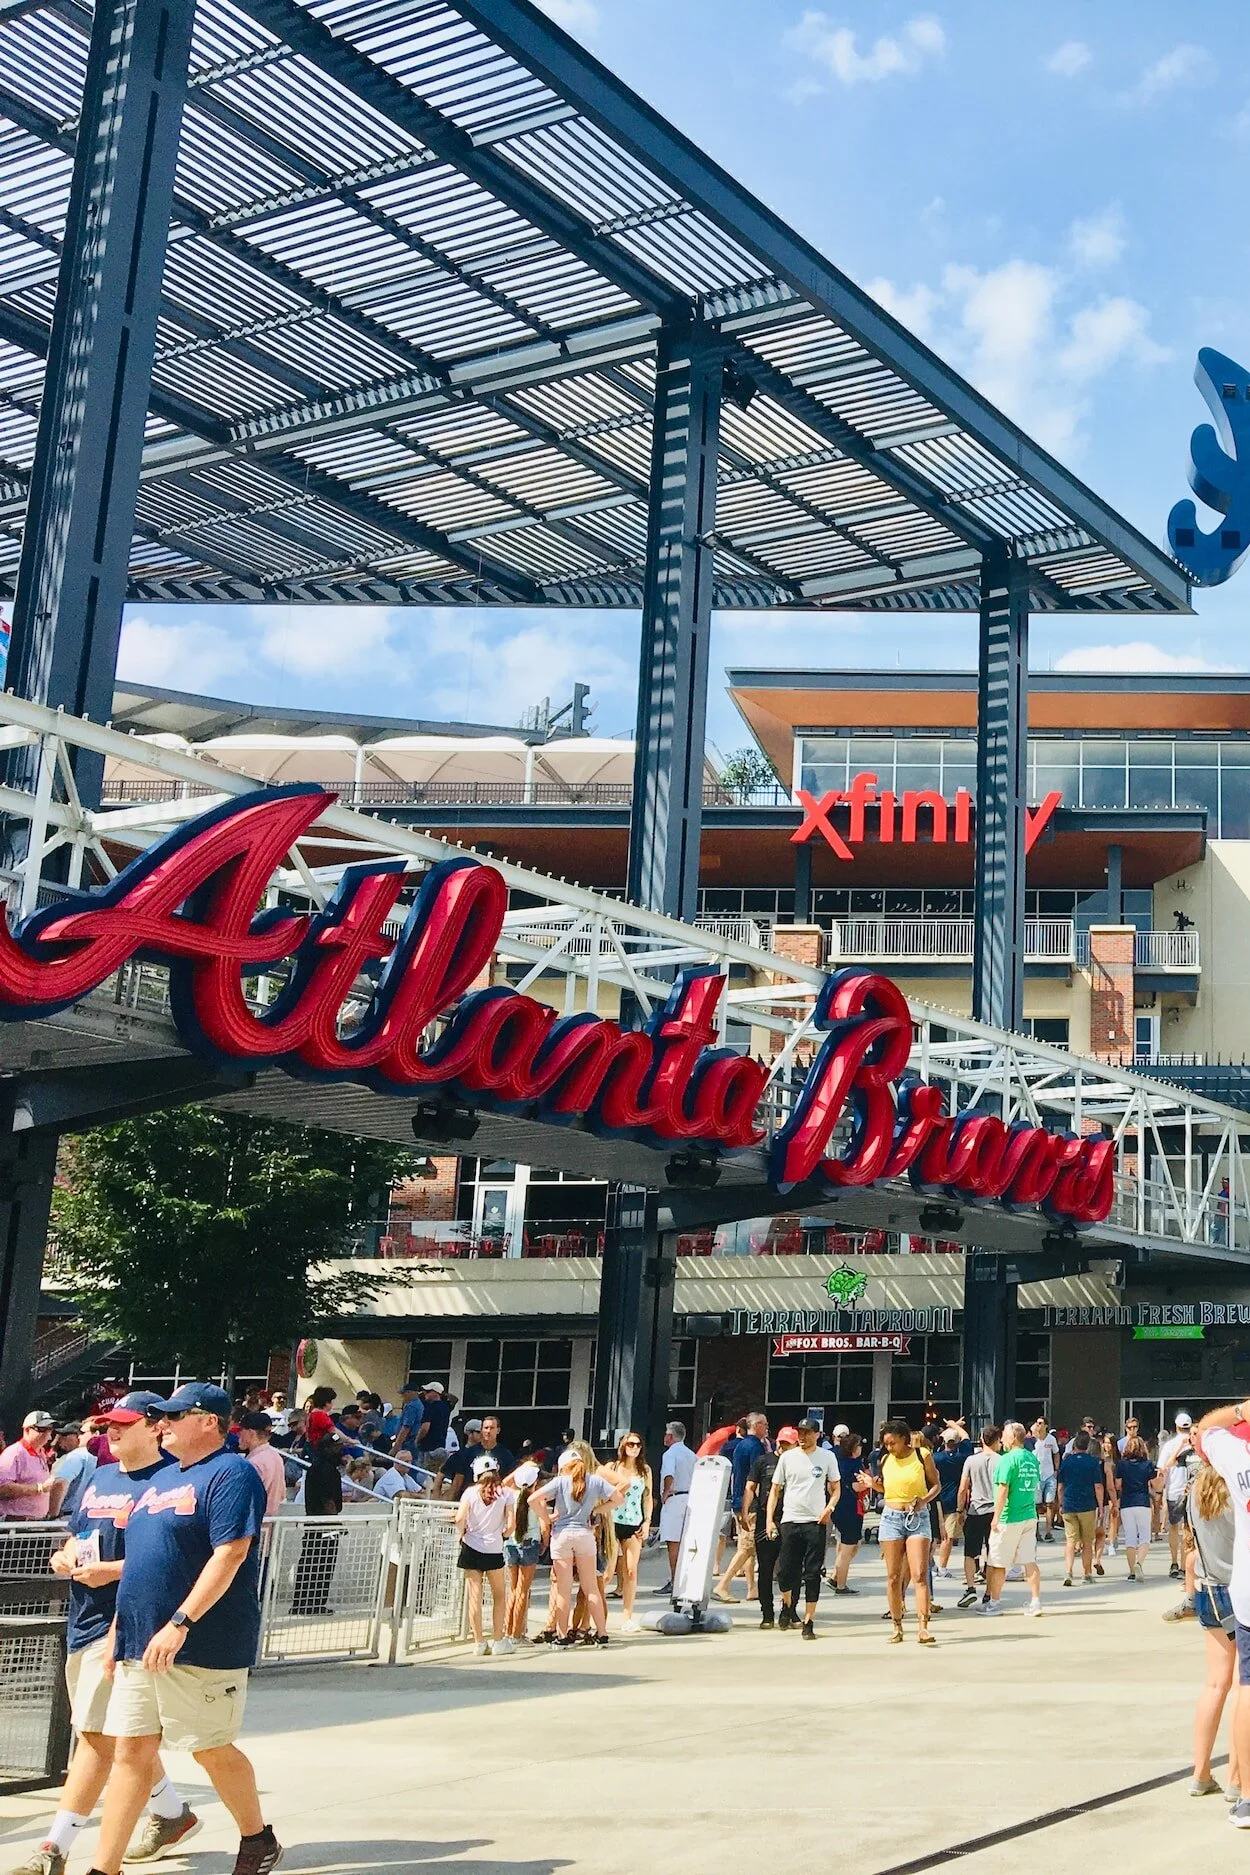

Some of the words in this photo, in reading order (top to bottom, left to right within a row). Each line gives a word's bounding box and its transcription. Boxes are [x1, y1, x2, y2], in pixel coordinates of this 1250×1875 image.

[789, 772, 1064, 860] xfiniy
[0, 781, 772, 1150] Atlanta
[772, 967, 1116, 1228] Braves
[729, 1307, 841, 1336] TERRAPIN
[848, 1305, 954, 1333] TAPROOM
[1041, 1303, 1133, 1327] TERRAPIN
[1137, 1301, 1195, 1326] FRESH
[797, 1337, 819, 1349] FOX
[821, 1337, 853, 1349] BROS.
[856, 1336, 901, 1349] BAR-B-Q
